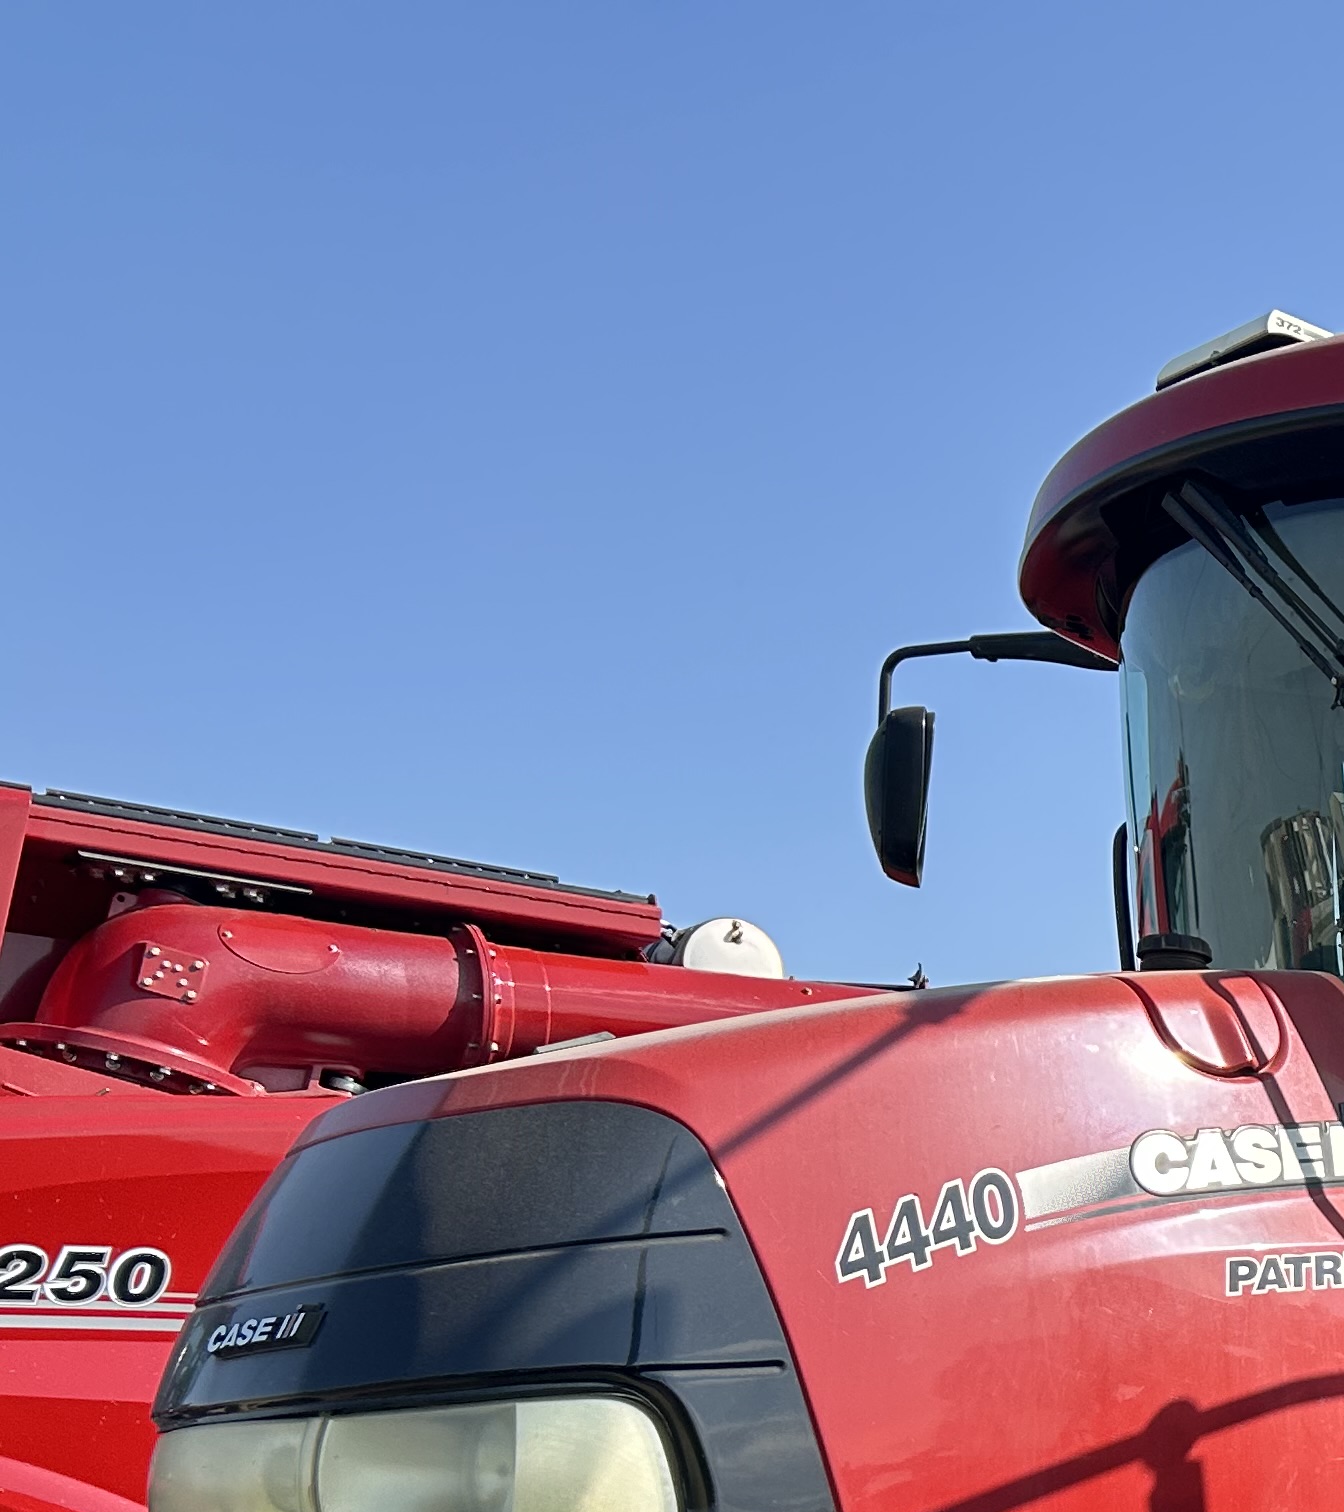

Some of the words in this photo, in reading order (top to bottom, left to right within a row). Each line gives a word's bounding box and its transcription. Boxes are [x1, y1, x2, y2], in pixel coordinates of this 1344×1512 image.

[1275, 316, 1302, 336] 372
[1131, 1125, 1326, 1193] CASE
[835, 1166, 1020, 1289] 4440
[0, 1243, 171, 1307] 250
[207, 1316, 277, 1353] CASE
